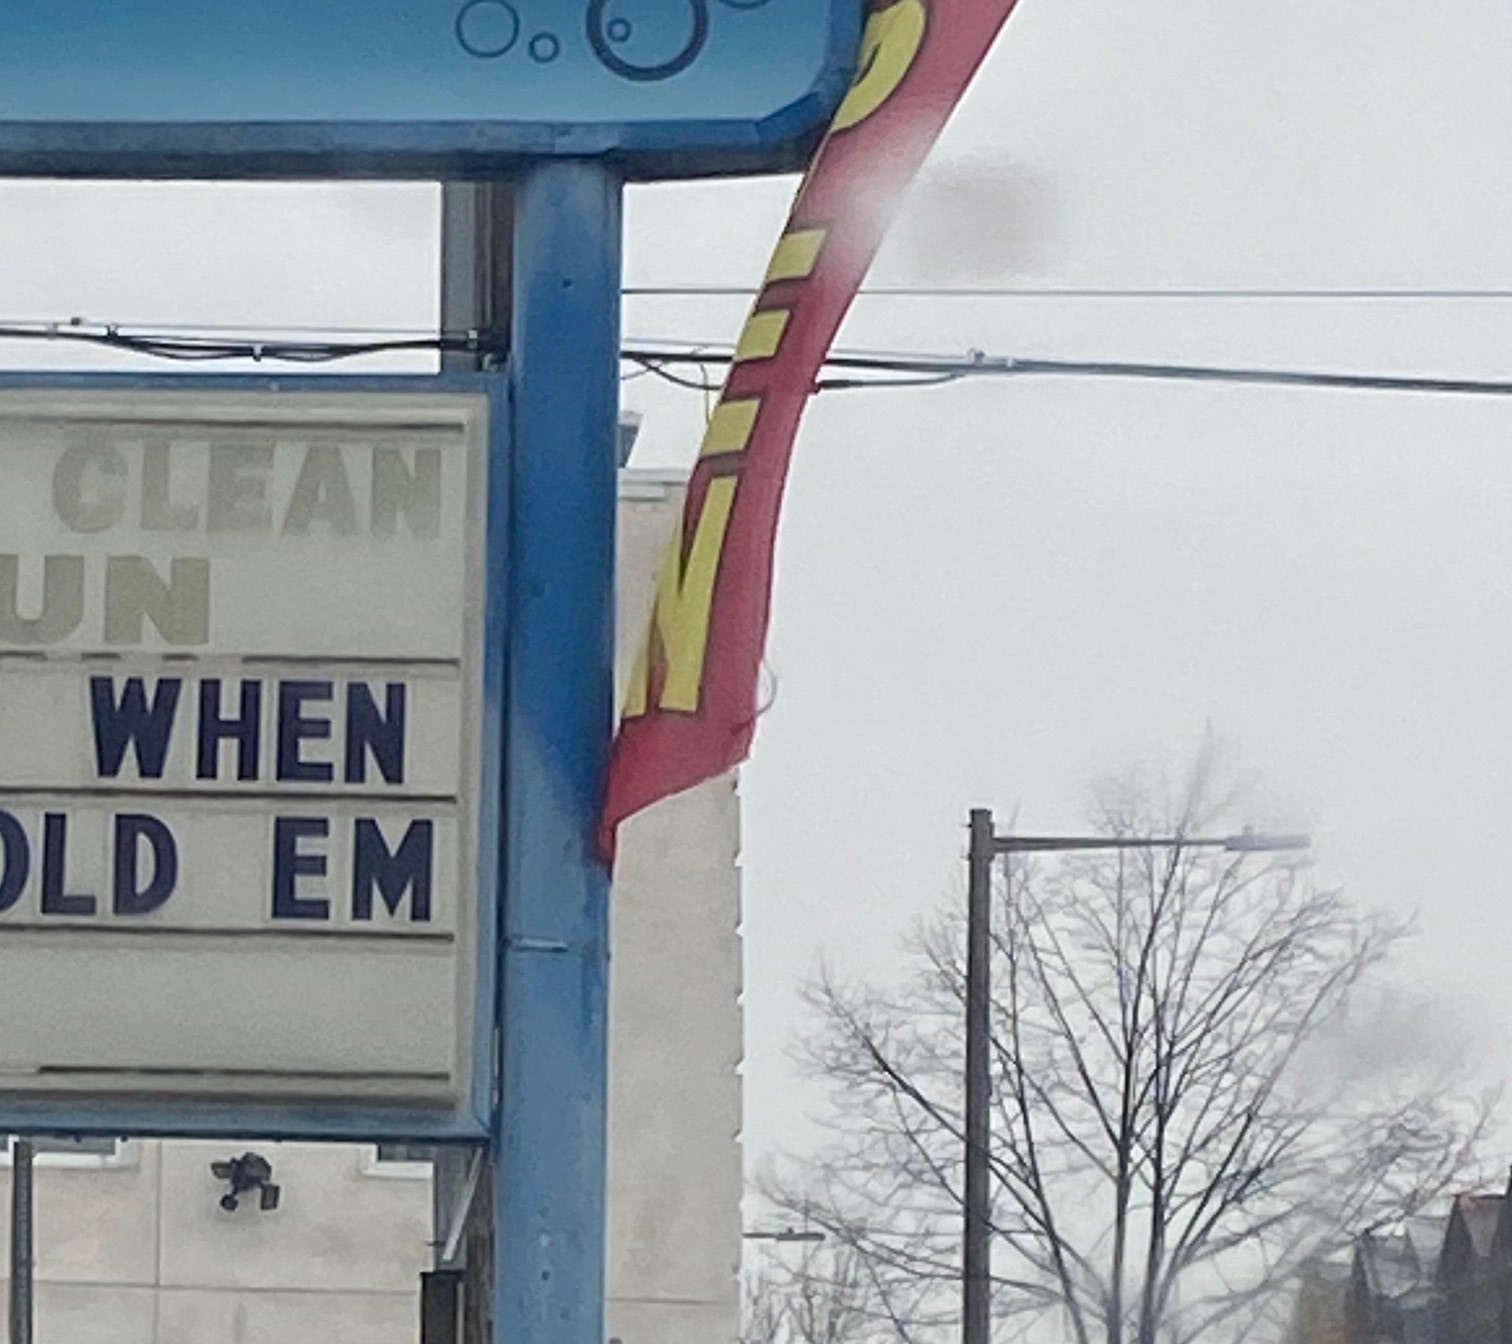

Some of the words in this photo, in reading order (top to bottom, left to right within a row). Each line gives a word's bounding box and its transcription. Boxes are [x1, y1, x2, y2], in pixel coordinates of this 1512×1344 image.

[50, 434, 443, 538] CLEAN
[90, 676, 407, 785] WHEN
[270, 816, 435, 923] EM
